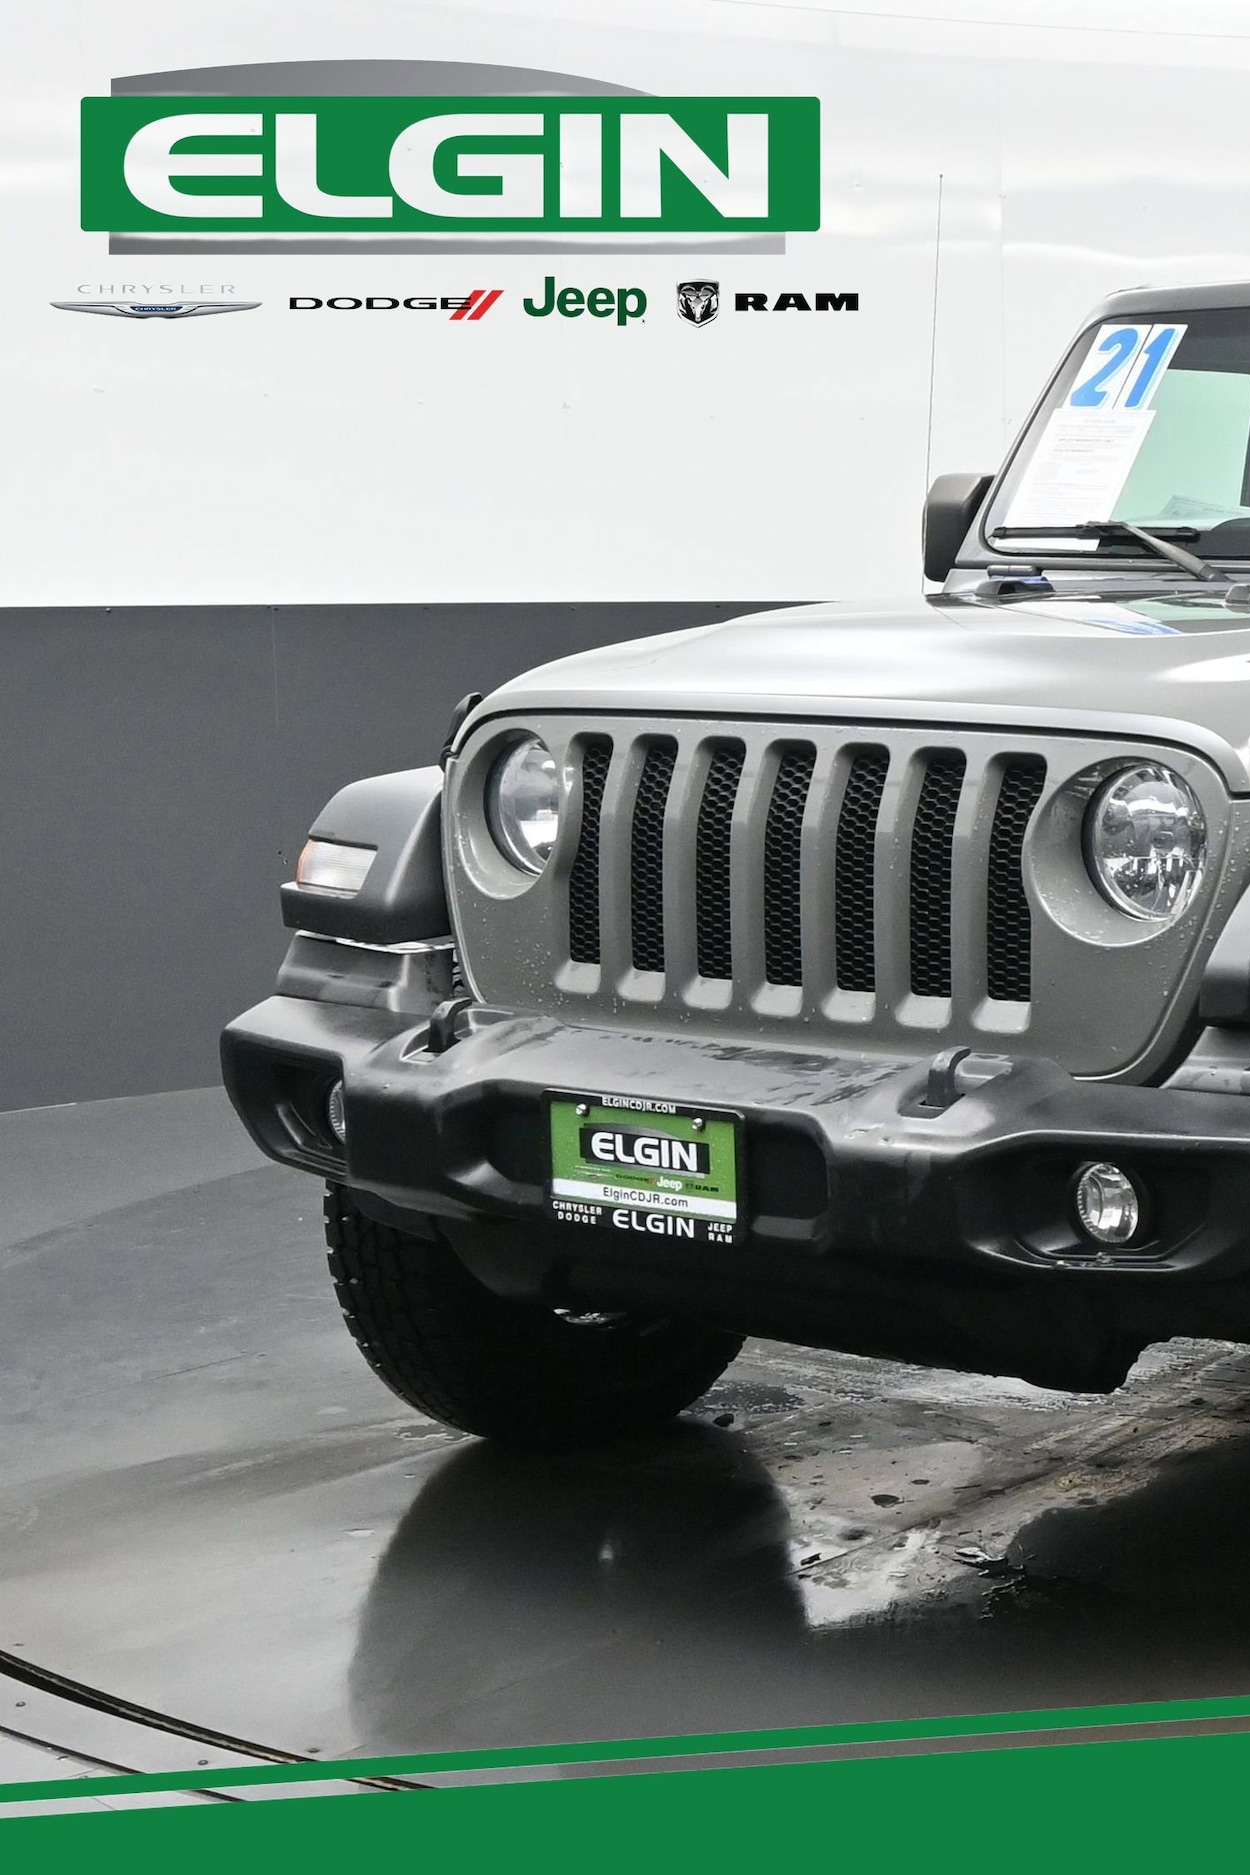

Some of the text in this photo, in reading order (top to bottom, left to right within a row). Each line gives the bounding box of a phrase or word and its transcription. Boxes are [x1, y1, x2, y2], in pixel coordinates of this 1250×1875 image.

[1070, 328, 1178, 408] 21
[601, 1096, 677, 1114] ELGINCDJR.COM
[590, 1131, 698, 1172] ELGIN
[657, 1176, 683, 1191] Jeep
[603, 1186, 689, 1208] ElginCDJR.com
[552, 1200, 603, 1216] CHRYSLER
[557, 1211, 597, 1225] DODGE
[612, 1209, 695, 1239] ELGIN
[707, 1223, 733, 1233] JEEP
[708, 1232, 733, 1244] RAM
